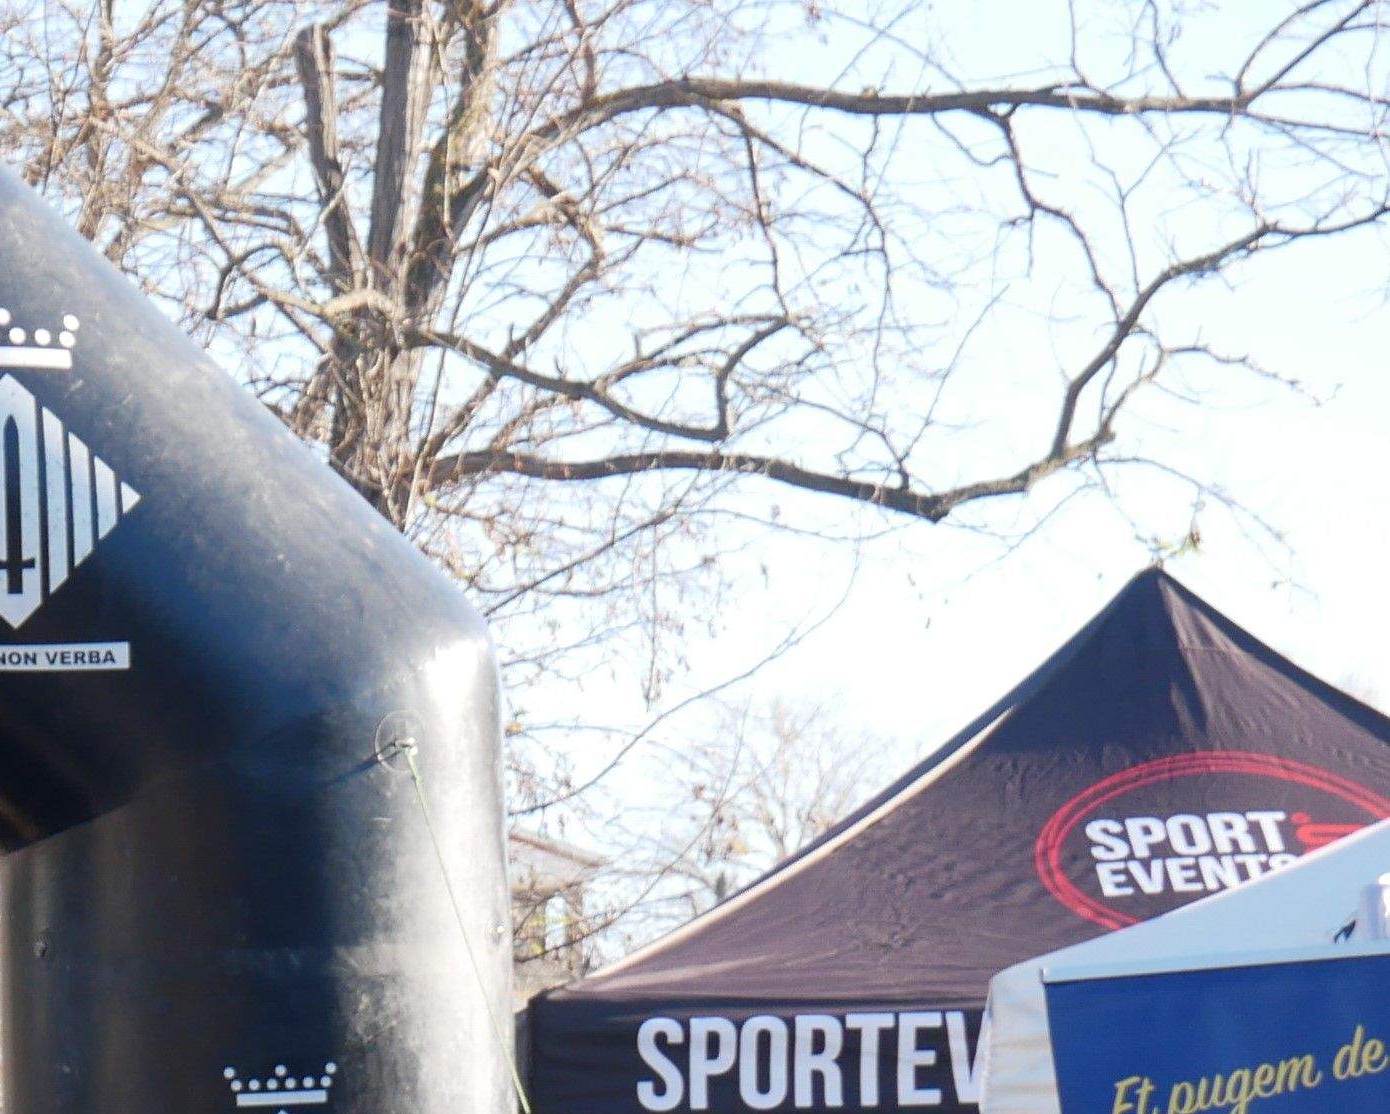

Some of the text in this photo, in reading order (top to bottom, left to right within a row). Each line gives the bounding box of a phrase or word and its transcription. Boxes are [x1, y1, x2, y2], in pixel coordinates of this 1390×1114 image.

[44, 650, 116, 665] VERBA
[1085, 811, 1286, 861] SPORT
[1333, 1024, 1389, 1081] de
